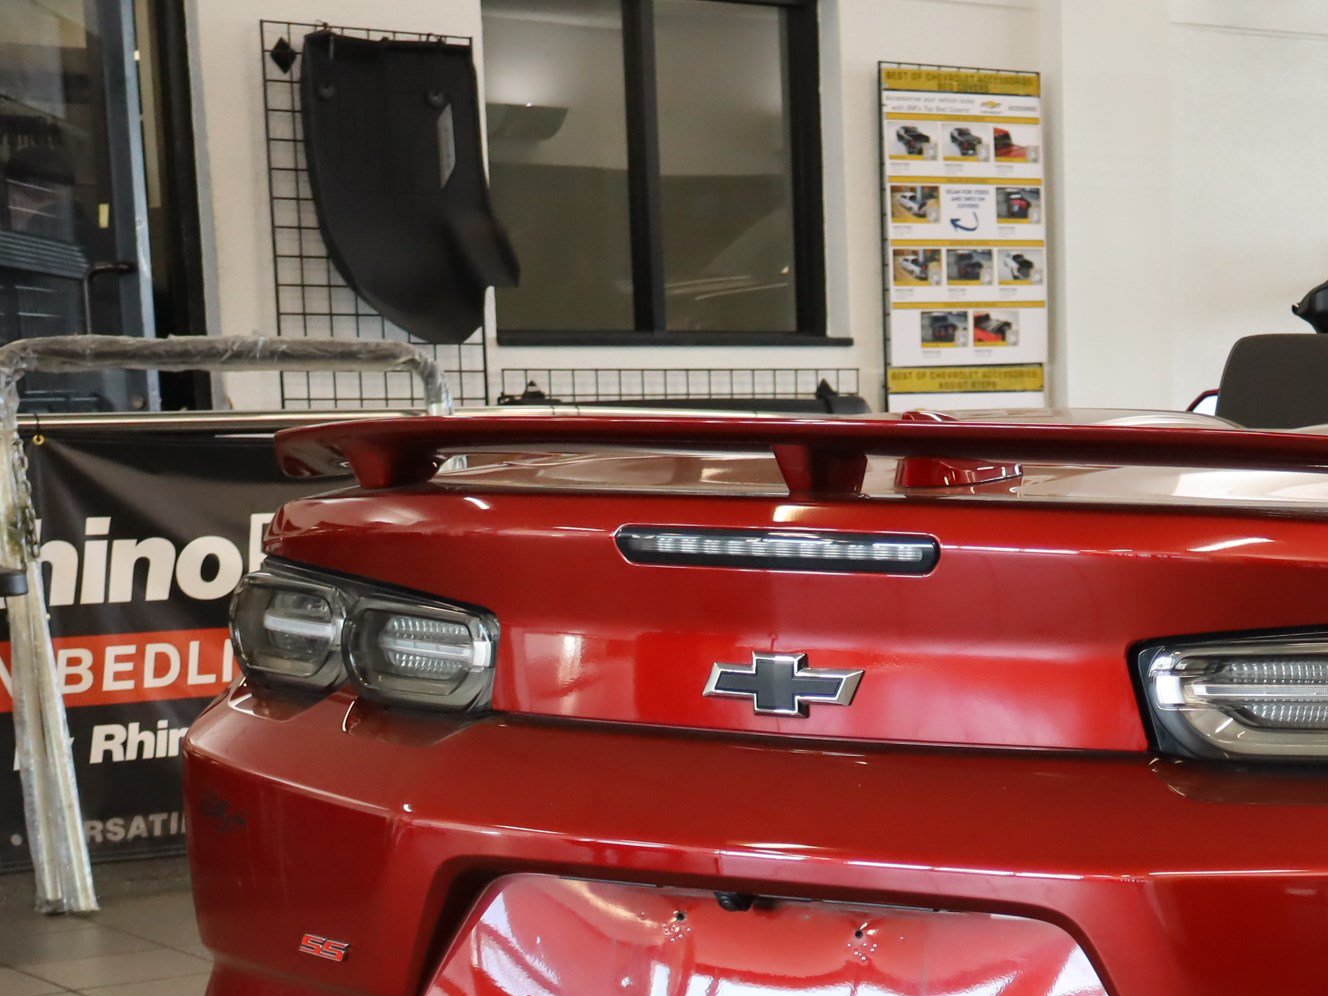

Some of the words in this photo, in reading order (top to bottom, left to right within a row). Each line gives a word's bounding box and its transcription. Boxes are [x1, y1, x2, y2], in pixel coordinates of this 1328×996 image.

[57, 638, 235, 694] BEDLI
[89, 719, 190, 765] Rhin
[299, 933, 351, 962] SS
